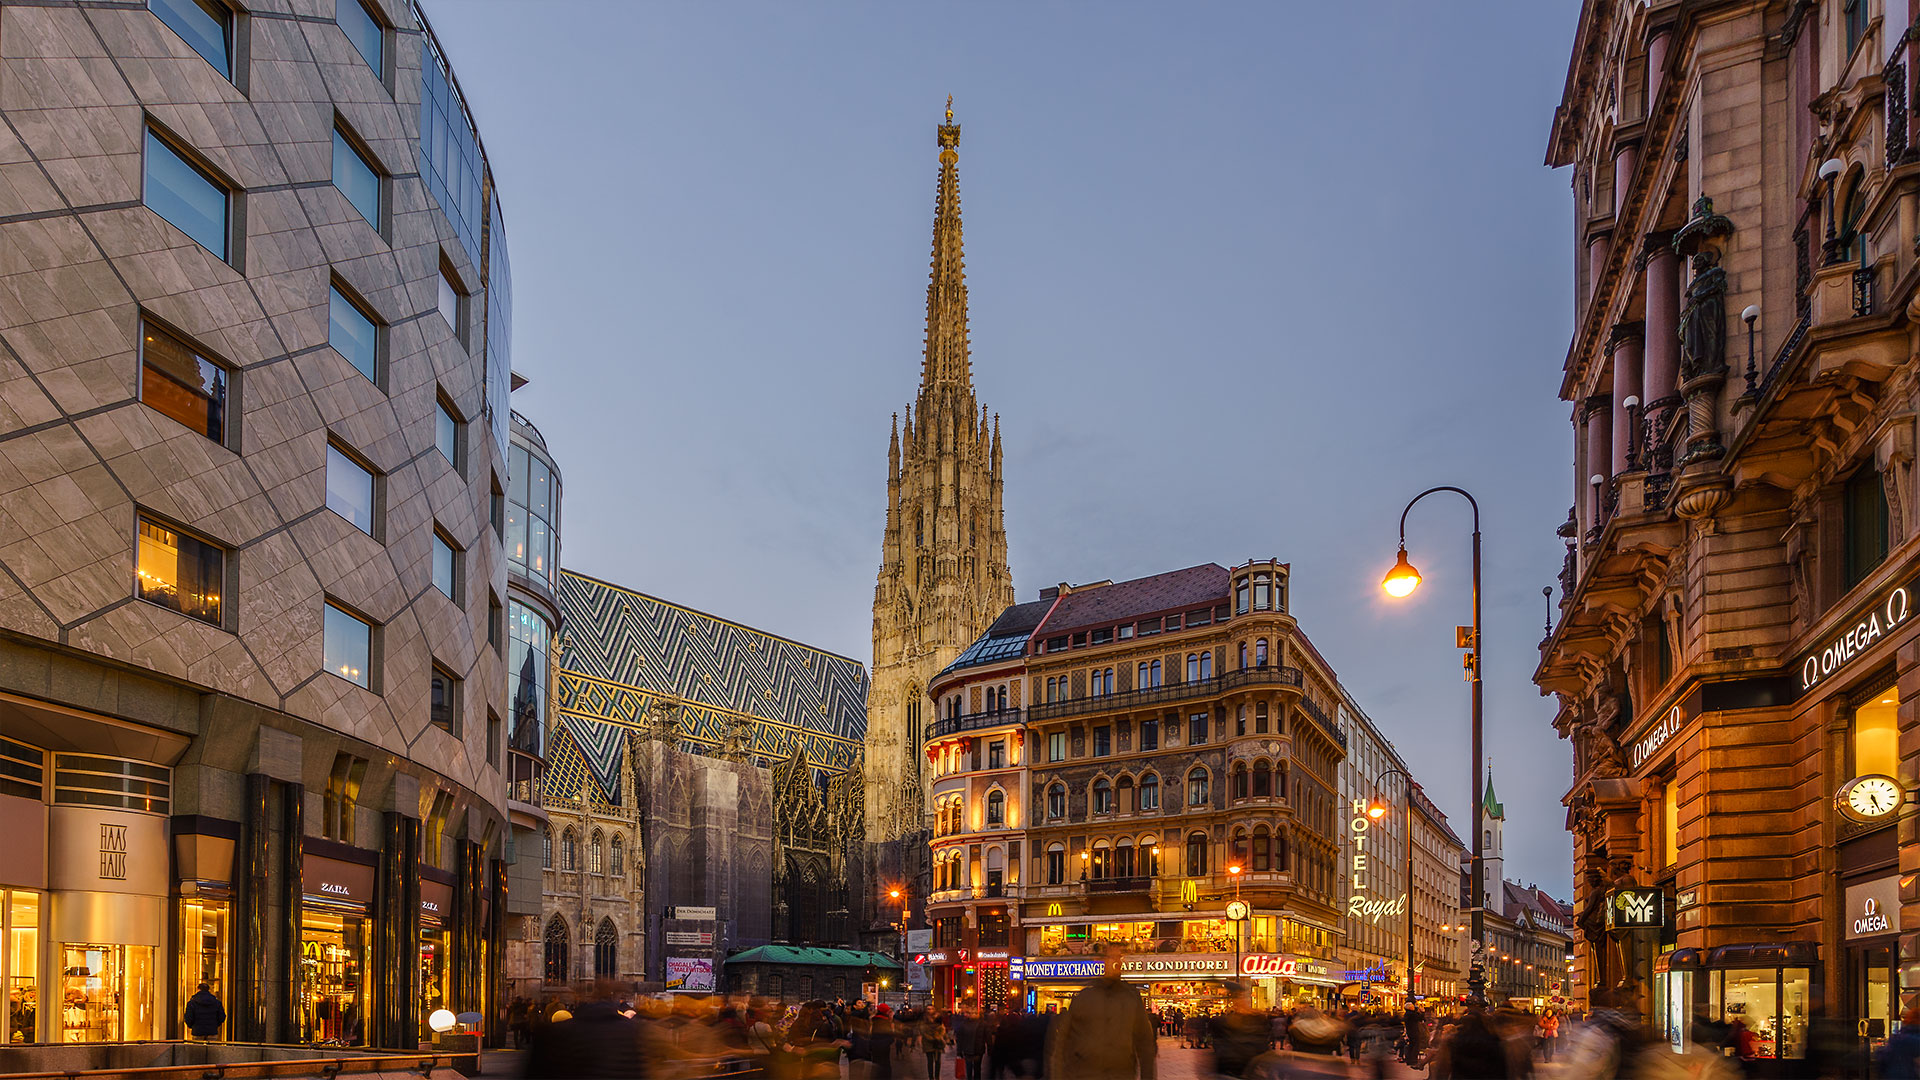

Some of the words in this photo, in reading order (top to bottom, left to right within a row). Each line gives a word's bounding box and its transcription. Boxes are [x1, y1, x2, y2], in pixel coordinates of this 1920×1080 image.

[1822, 612, 1881, 675] OMEGA
[1642, 719, 1669, 759] OMEGA
[100, 826, 127, 851] HAAS
[1351, 798, 1369, 890] HOTEL
[100, 853, 126, 877] HAUS
[321, 883, 350, 895] ZARA
[1347, 893, 1407, 924] Royal
[1854, 914, 1889, 934] OMEGA
[1025, 963, 1056, 976] MONEY
[1057, 962, 1106, 976] EXCHANGE
[1147, 960, 1228, 971] KONDITOREI
